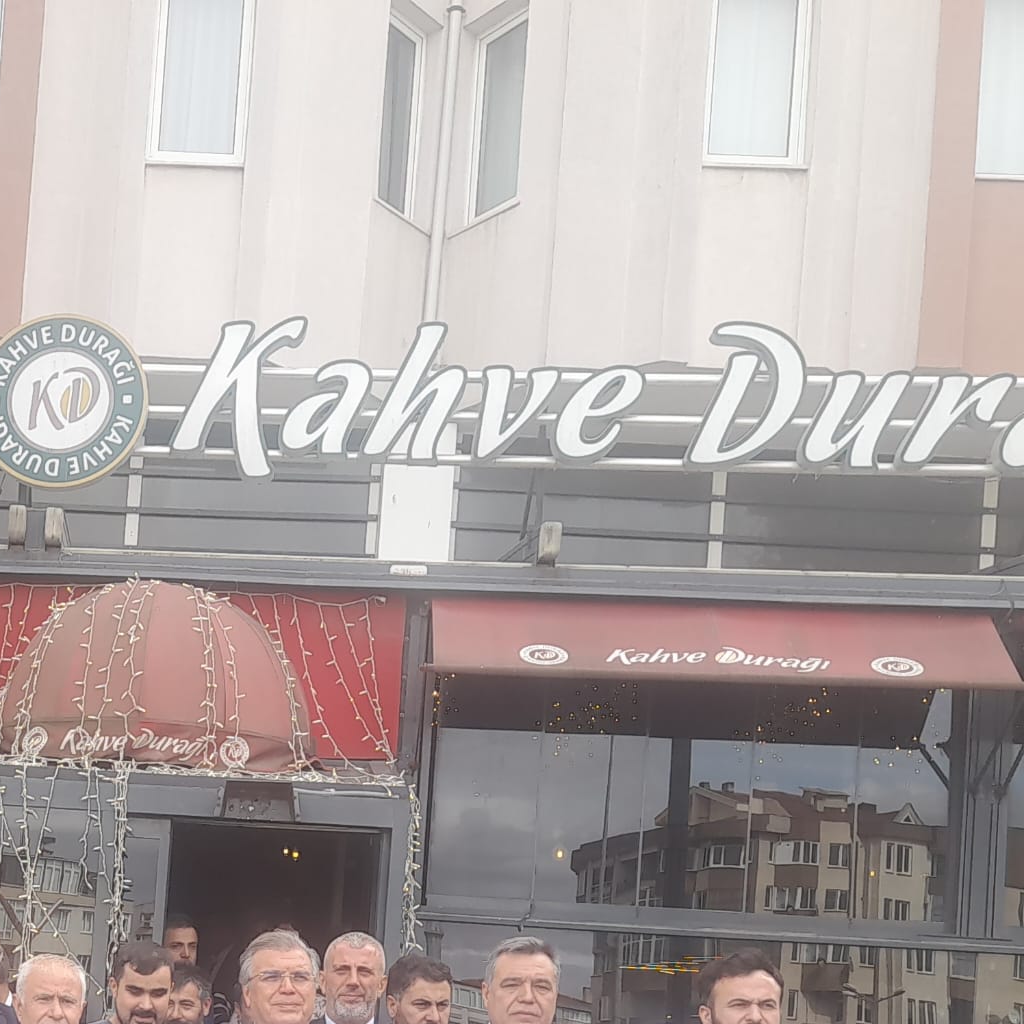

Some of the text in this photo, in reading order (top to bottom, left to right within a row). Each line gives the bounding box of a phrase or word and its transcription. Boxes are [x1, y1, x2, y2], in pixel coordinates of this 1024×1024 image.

[60, 323, 136, 385] DURAĞI
[27, 366, 101, 431] KD
[170, 316, 645, 478] Kahve
[66, 414, 134, 476] KAHVE
[606, 648, 707, 665] Kahve
